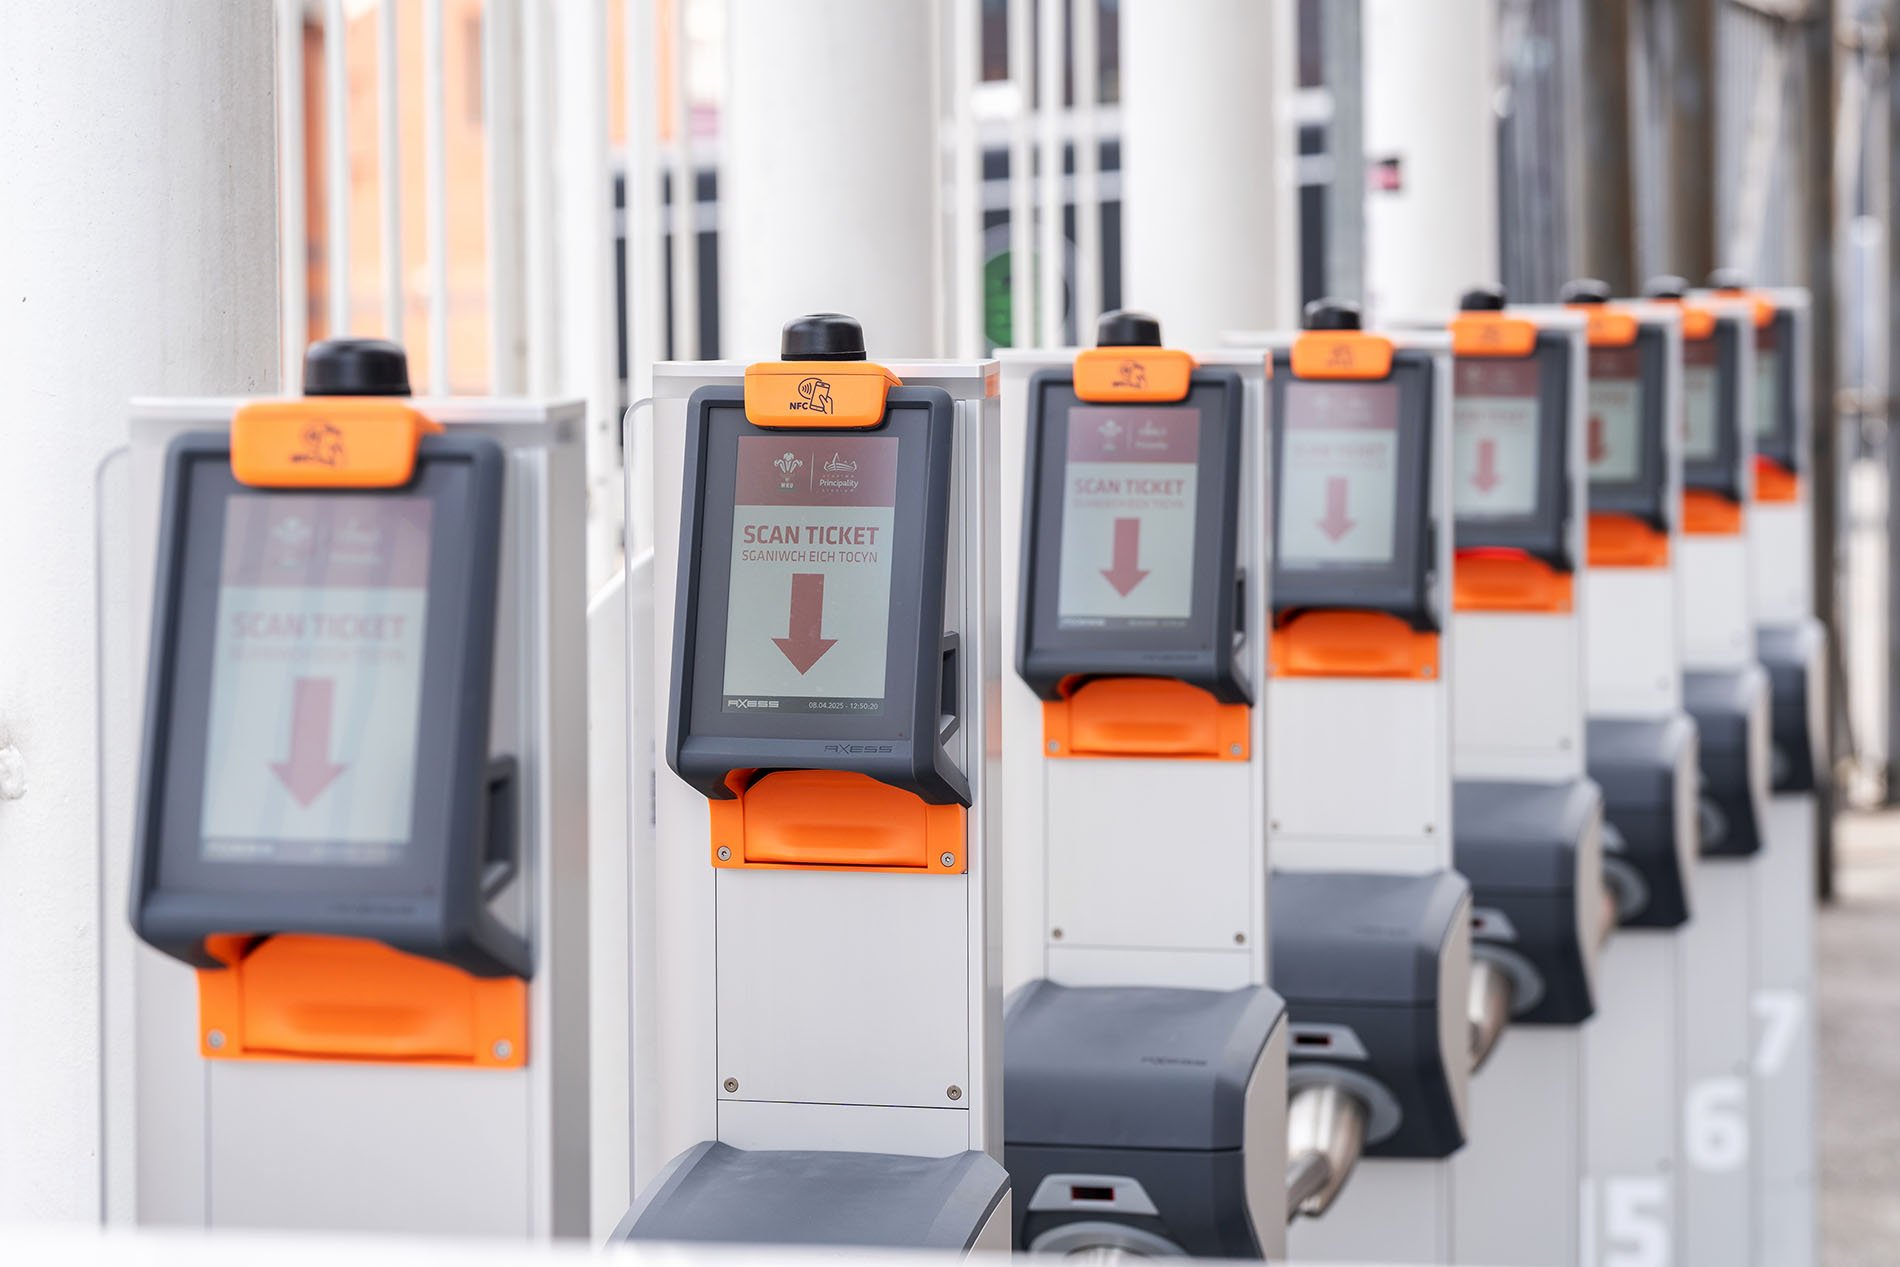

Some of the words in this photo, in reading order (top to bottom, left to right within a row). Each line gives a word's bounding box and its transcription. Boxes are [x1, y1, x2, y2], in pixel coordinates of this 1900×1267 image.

[789, 402, 808, 410] NFC
[819, 479, 858, 488] Principality
[743, 525, 800, 544] SCAN
[805, 526, 880, 545] TICKET
[742, 550, 806, 562] SGANIWCH
[809, 551, 835, 563] EICH
[838, 551, 878, 563] TOCYN
[823, 744, 893, 754] AXESS
[1752, 991, 1804, 1076] 7
[1685, 1078, 1748, 1171] 6
